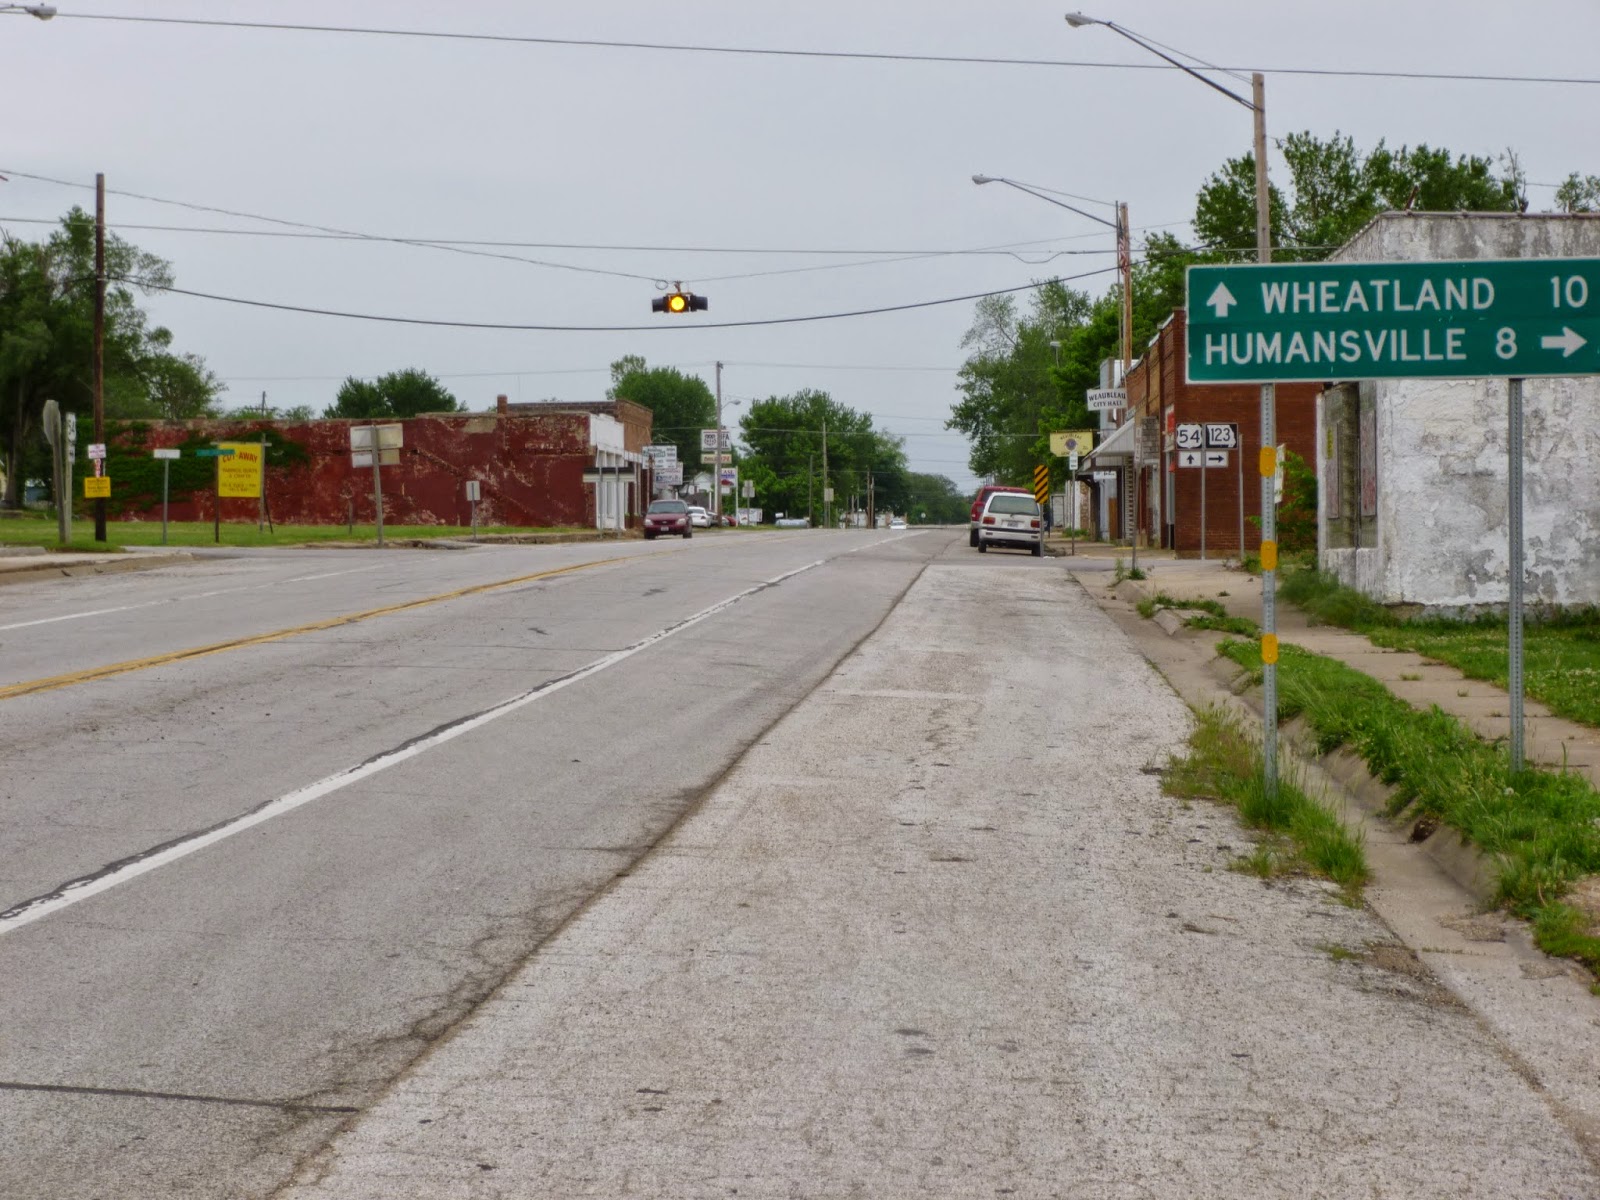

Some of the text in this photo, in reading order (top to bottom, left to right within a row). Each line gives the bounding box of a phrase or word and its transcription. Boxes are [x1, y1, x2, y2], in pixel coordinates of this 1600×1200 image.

[1261, 275, 1589, 314] WHEATLAND 10
[1205, 326, 1518, 366] HUMANSVILLE 8
[1089, 392, 1126, 401] WEAUBLEAU
[1179, 429, 1200, 443] 54
[1210, 427, 1231, 442] 123
